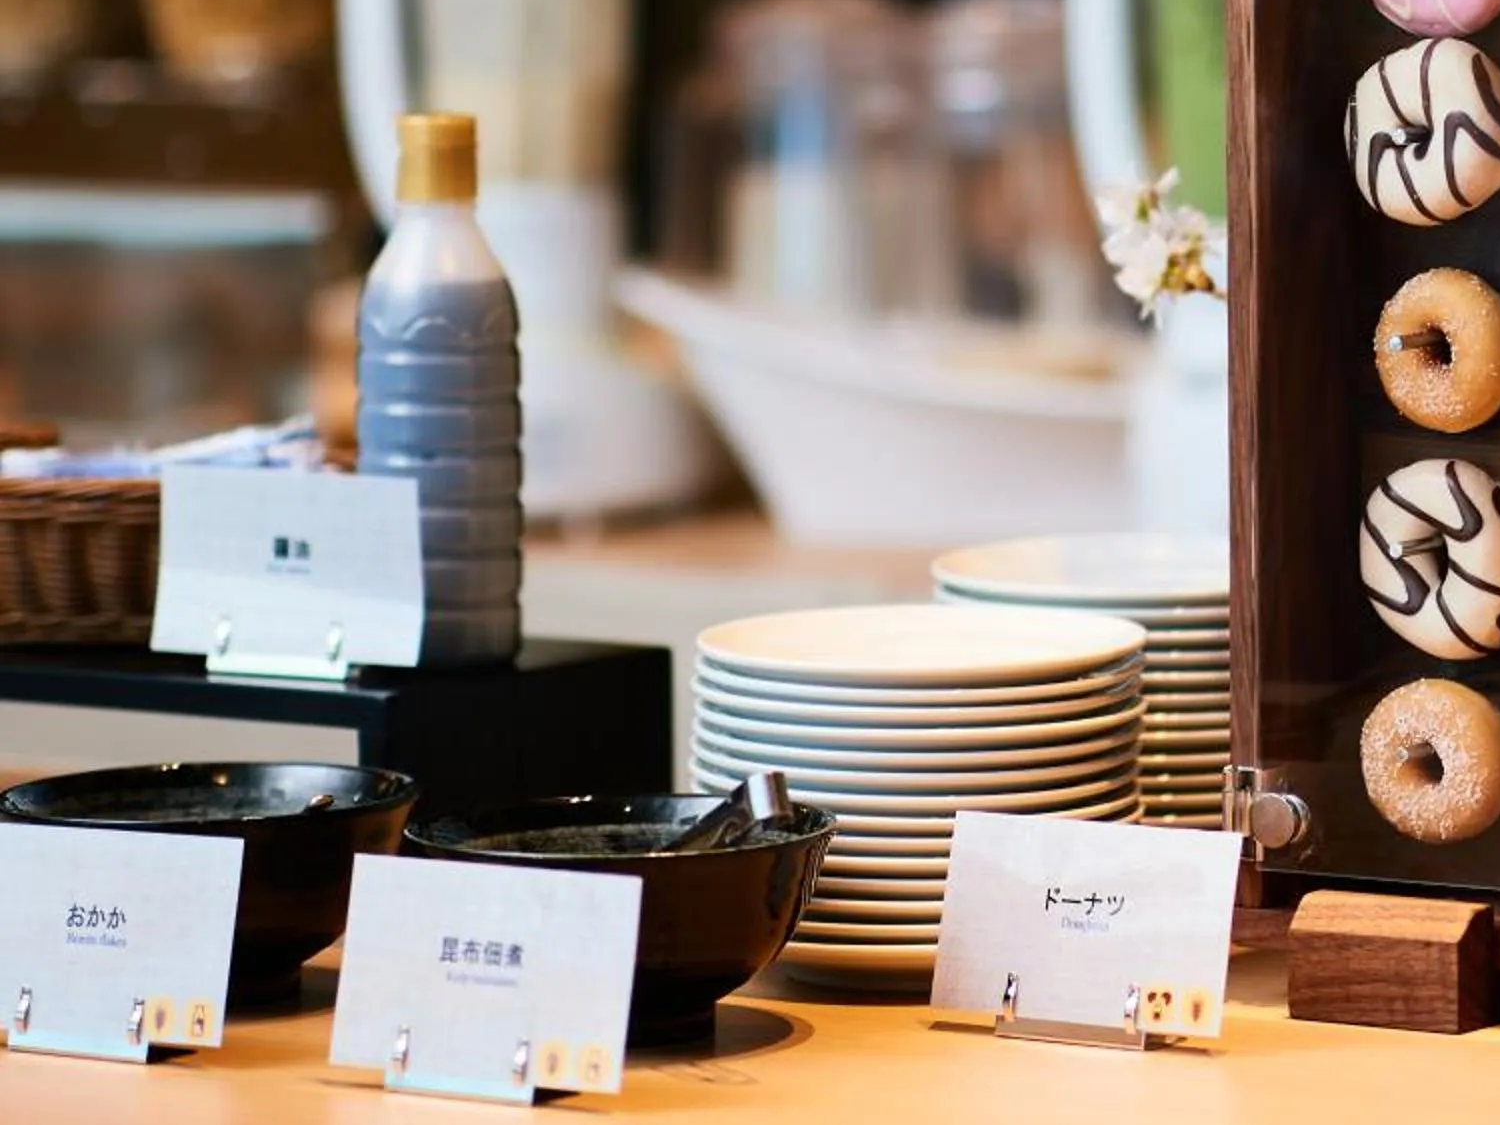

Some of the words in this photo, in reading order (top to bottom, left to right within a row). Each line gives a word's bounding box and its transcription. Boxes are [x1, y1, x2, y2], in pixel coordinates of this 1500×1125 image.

[66, 902, 127, 929] おかか
[1045, 887, 1125, 916] ドーナツ
